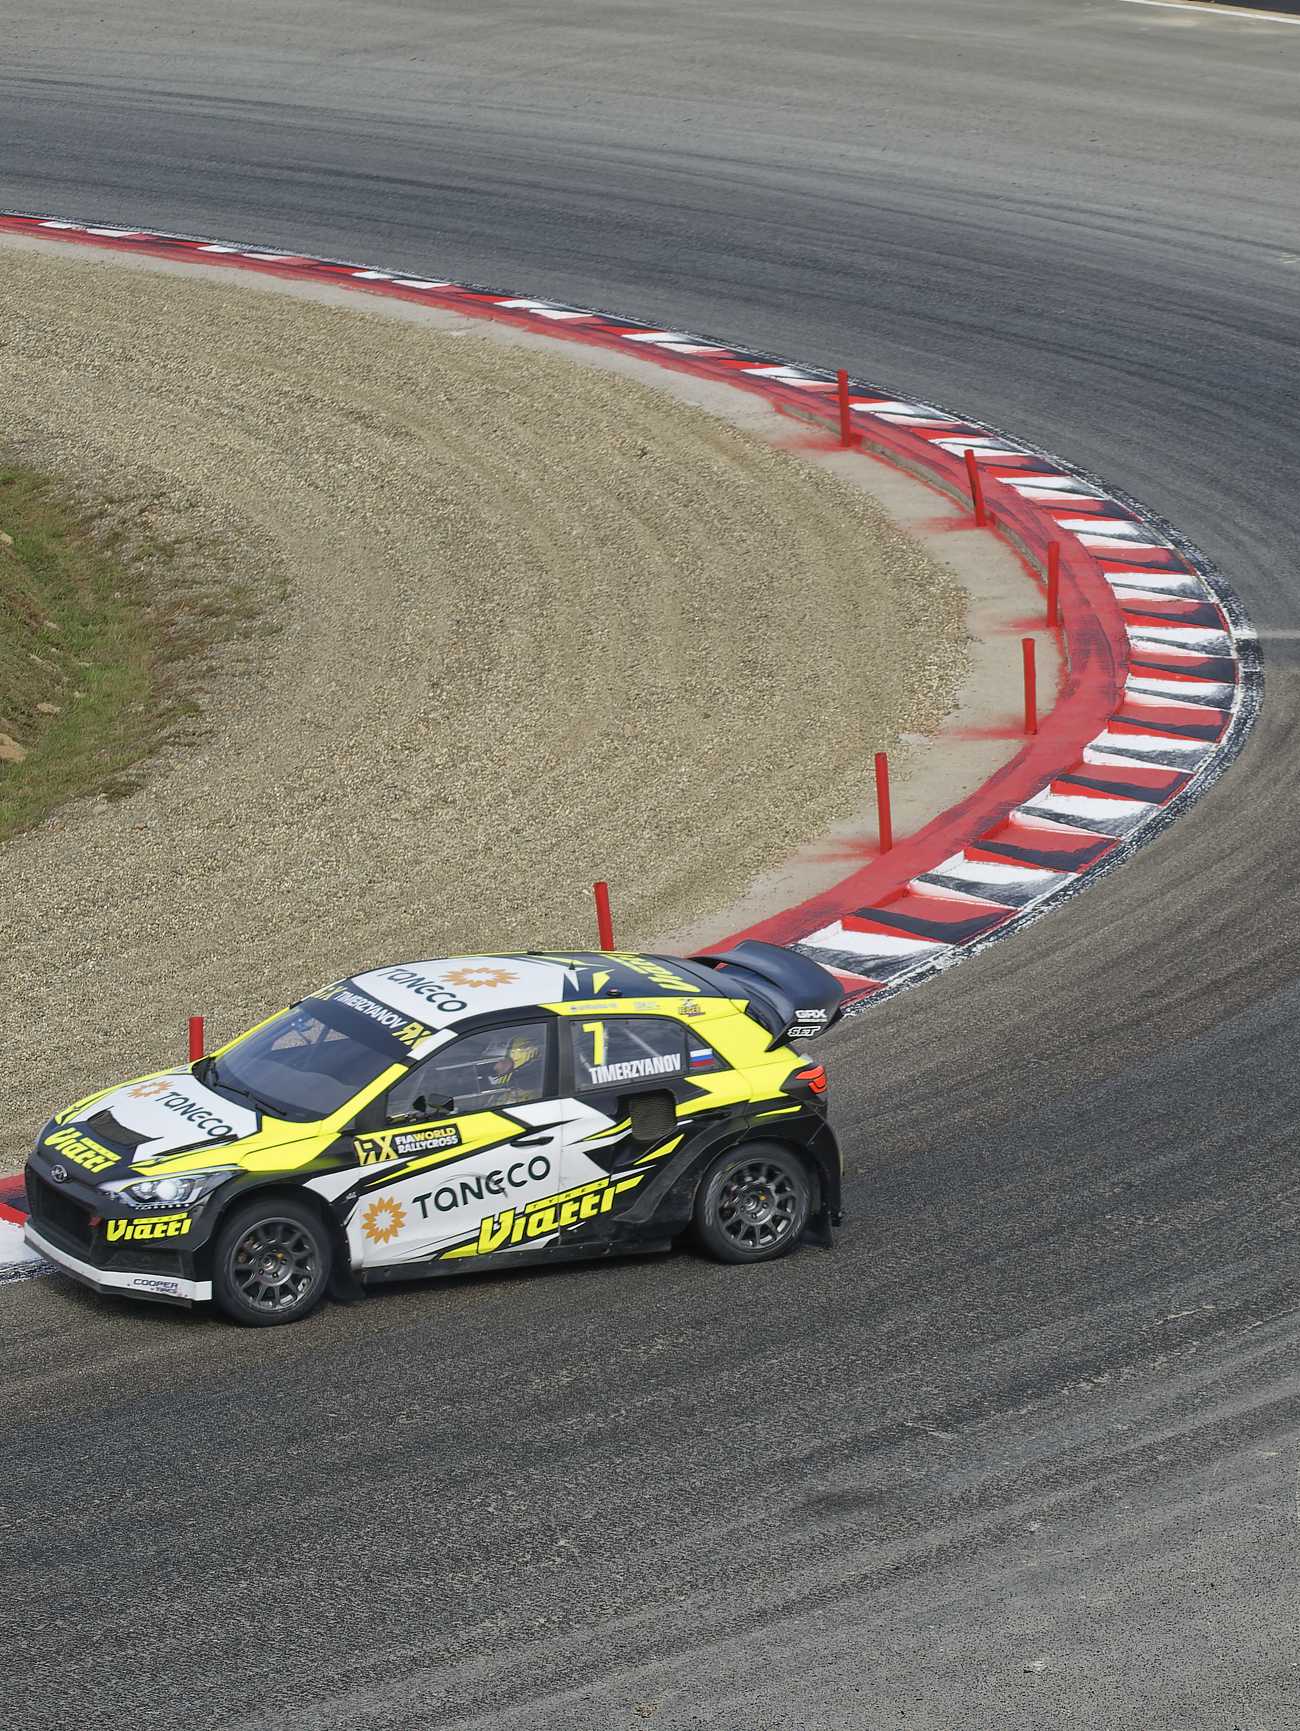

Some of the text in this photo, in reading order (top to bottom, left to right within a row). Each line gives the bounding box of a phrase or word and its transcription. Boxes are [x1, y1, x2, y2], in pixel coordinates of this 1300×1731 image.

[334, 991, 409, 1029] TIMERZYANOV
[589, 1053, 682, 1085] TIMERZYANOV
[394, 1127, 456, 1145] FIA WORLD
[397, 1135, 459, 1153] RALLYCROSS
[106, 1218, 193, 1242] Viatti
[478, 1186, 616, 1254] Viatti
[133, 1278, 179, 1289] COOPER
